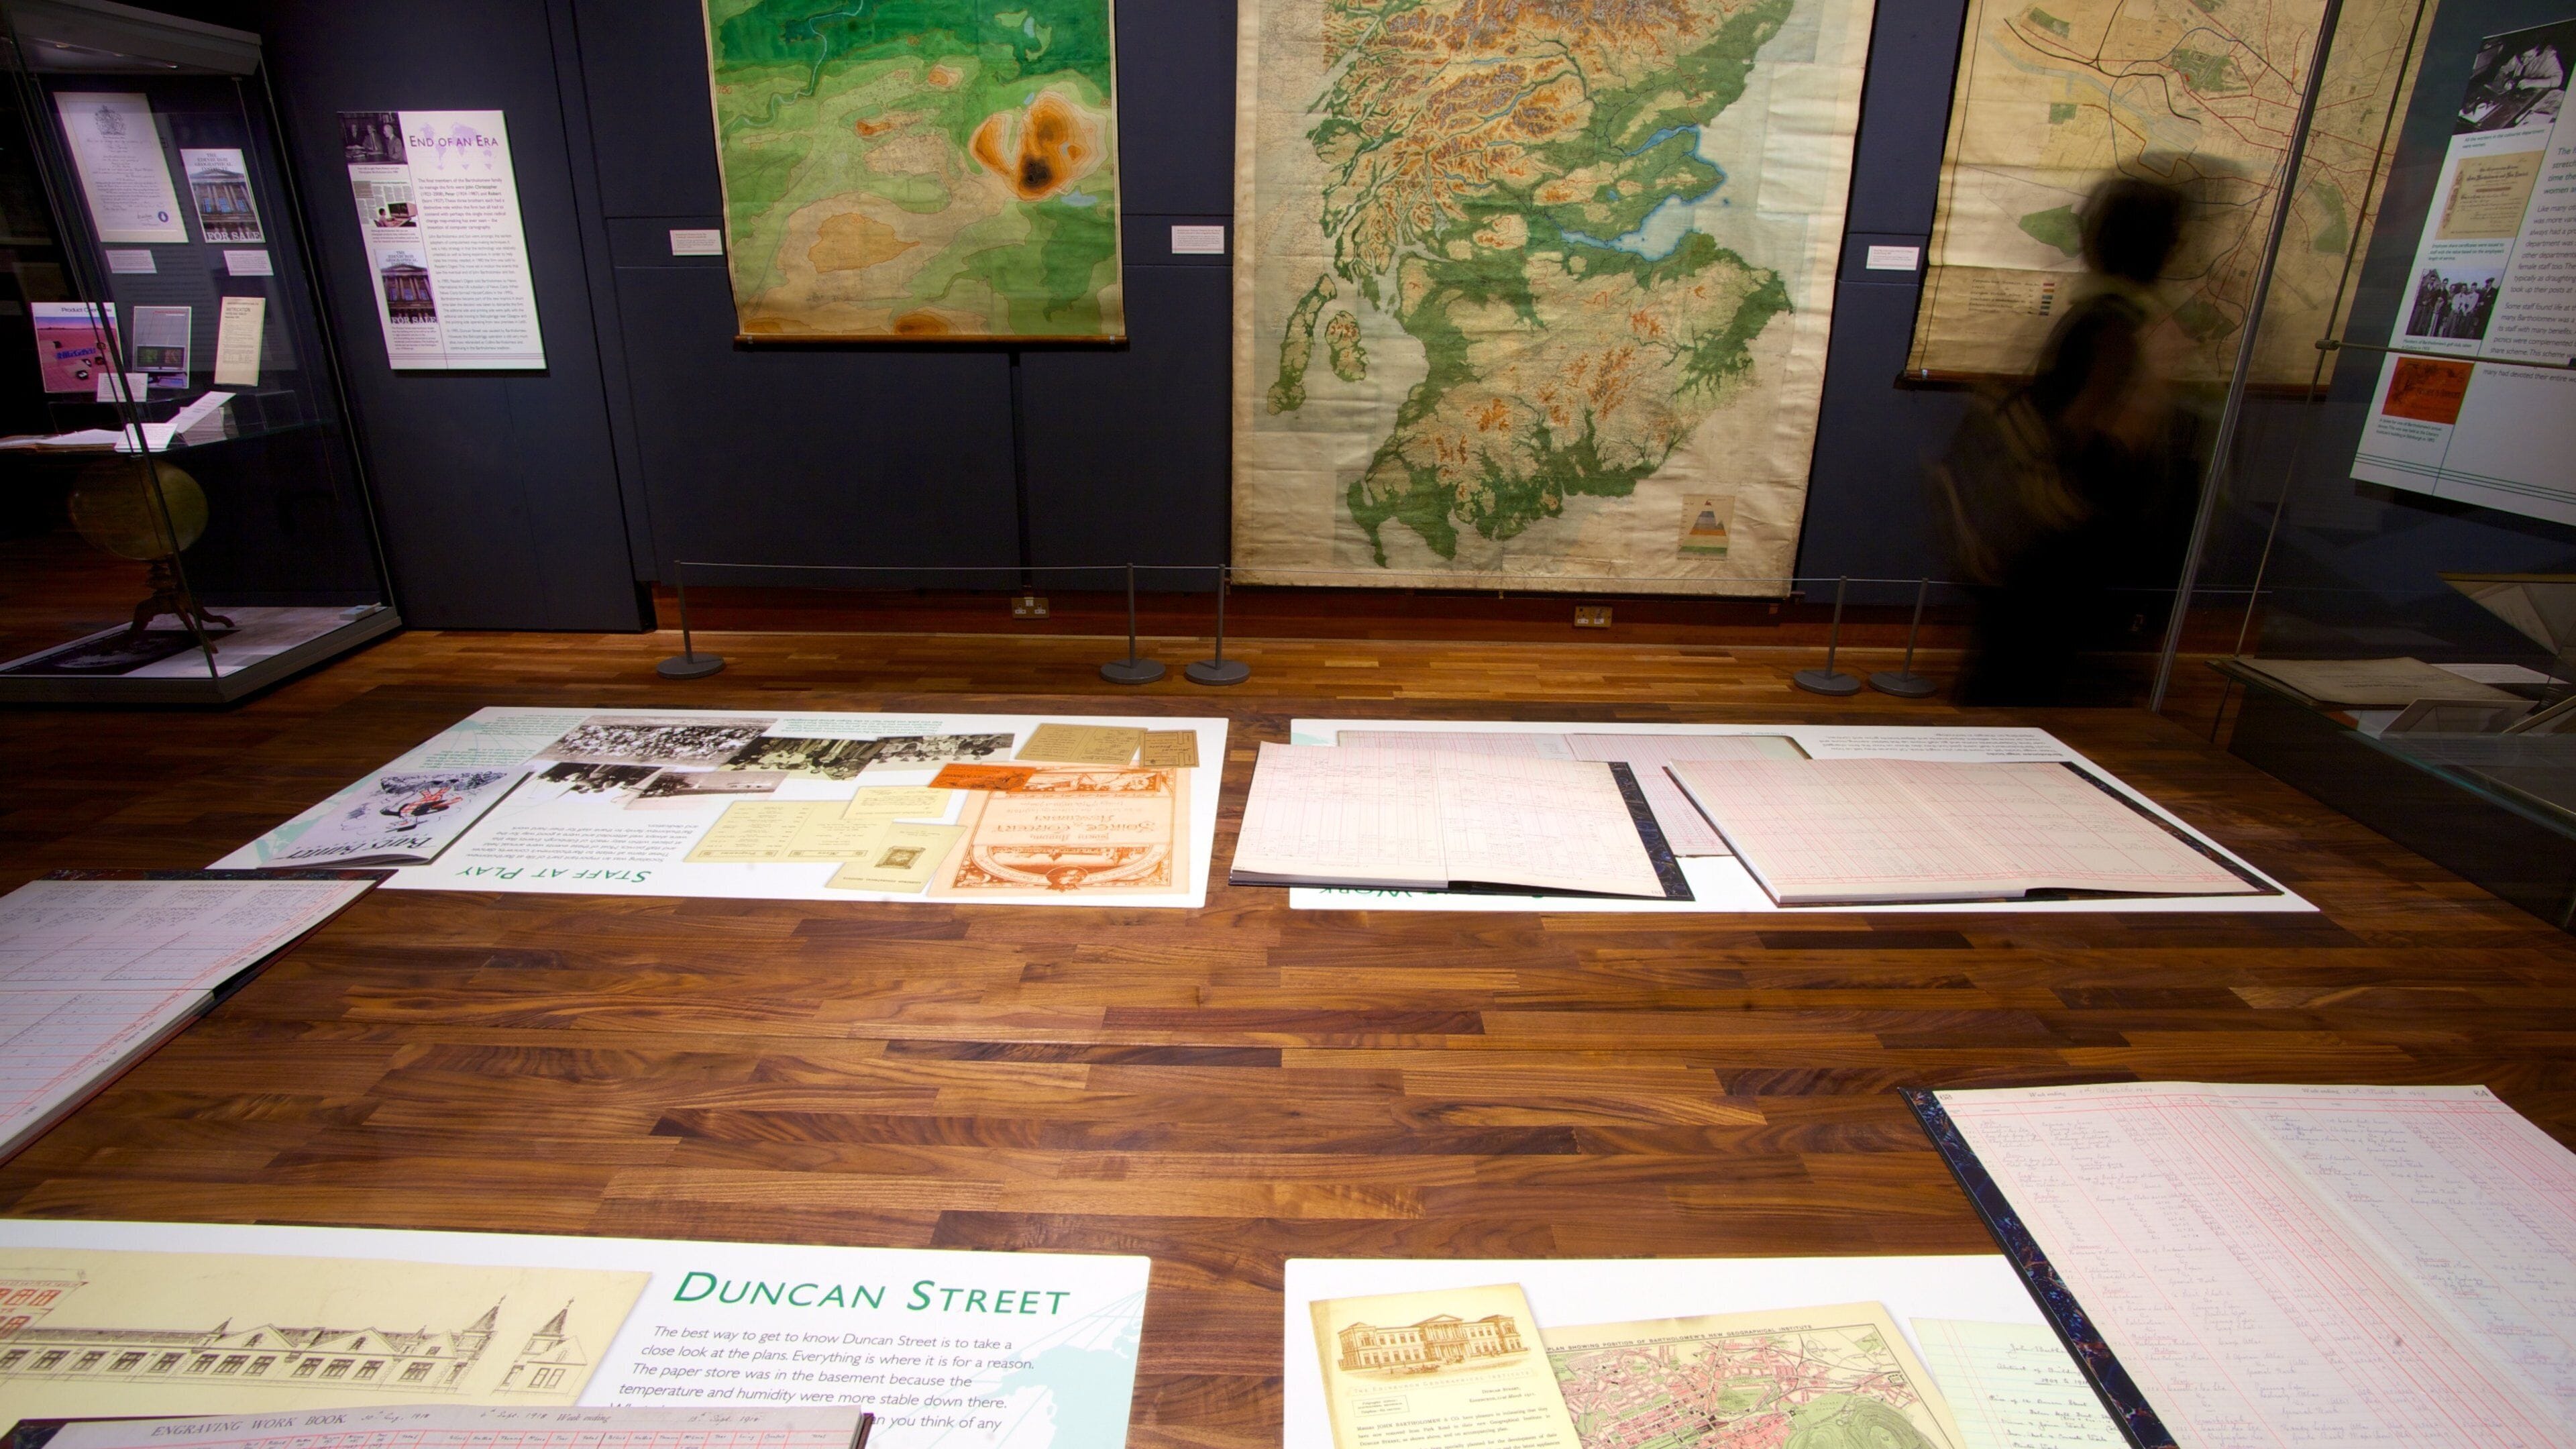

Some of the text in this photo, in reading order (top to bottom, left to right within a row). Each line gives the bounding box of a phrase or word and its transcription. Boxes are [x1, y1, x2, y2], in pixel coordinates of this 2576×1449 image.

[409, 136, 434, 147] END
[438, 138, 453, 146] OF
[476, 135, 498, 147] ERA
[207, 232, 261, 241] FOR SALE
[392, 316, 411, 324] FOR
[2517, 314, 2556, 322] Bartholomew
[2528, 339, 2573, 347] complemented
[2542, 350, 2565, 358] scheme
[2483, 369, 2568, 382] many had devoted their entire
[456, 866, 652, 883] STAFF AT PLAY
[673, 1271, 1071, 1315] DUNCAN STREET
[654, 1326, 1012, 1350] The best way to get to know Duncan Street is to take a
[1568, 1342, 1601, 1350] SHOWING
[1602, 1340, 1635, 1348] POSITION
[1649, 1333, 1707, 1343] BARTHOLOMEW'S
[1726, 1328, 1776, 1337] GEOGRAPHICAL
[1778, 1324, 1813, 1332] INSTITUTE
[641, 1345, 1034, 1370] close look at the plans. Everything is where it is for a reason.
[633, 1362, 972, 1387] The paper store was in the basement because the
[619, 1384, 1008, 1409] temperature and humidity were more stable down there.
[151, 1413, 348, 1437] ENGRAVING WORK BOOK
[872, 1415, 1002, 1432] an you think of any
